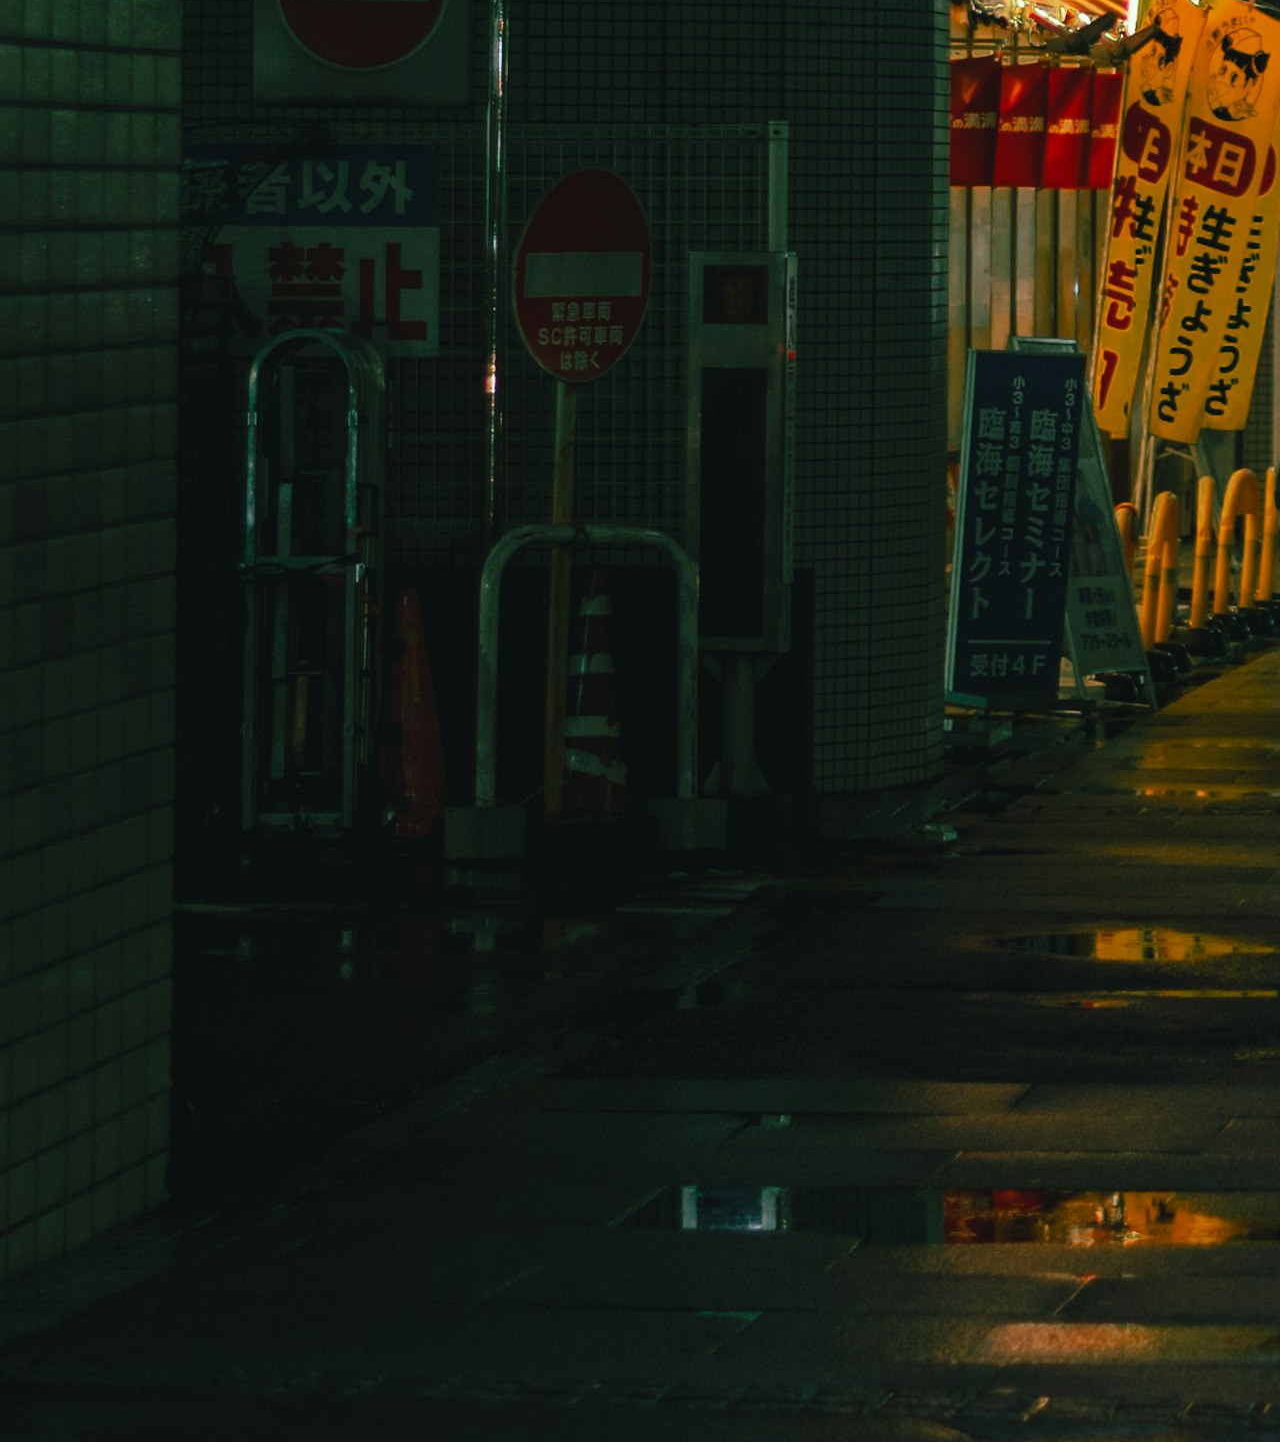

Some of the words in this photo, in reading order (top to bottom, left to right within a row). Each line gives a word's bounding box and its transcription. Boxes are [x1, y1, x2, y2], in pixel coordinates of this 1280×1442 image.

[1186, 129, 1247, 188] 本日
[1158, 203, 1236, 424] 生ぎょうざ
[968, 406, 1007, 621] 臨海セレクト
[1020, 408, 1059, 621] 臨海セミナー
[968, 654, 1048, 679] 受付4F
